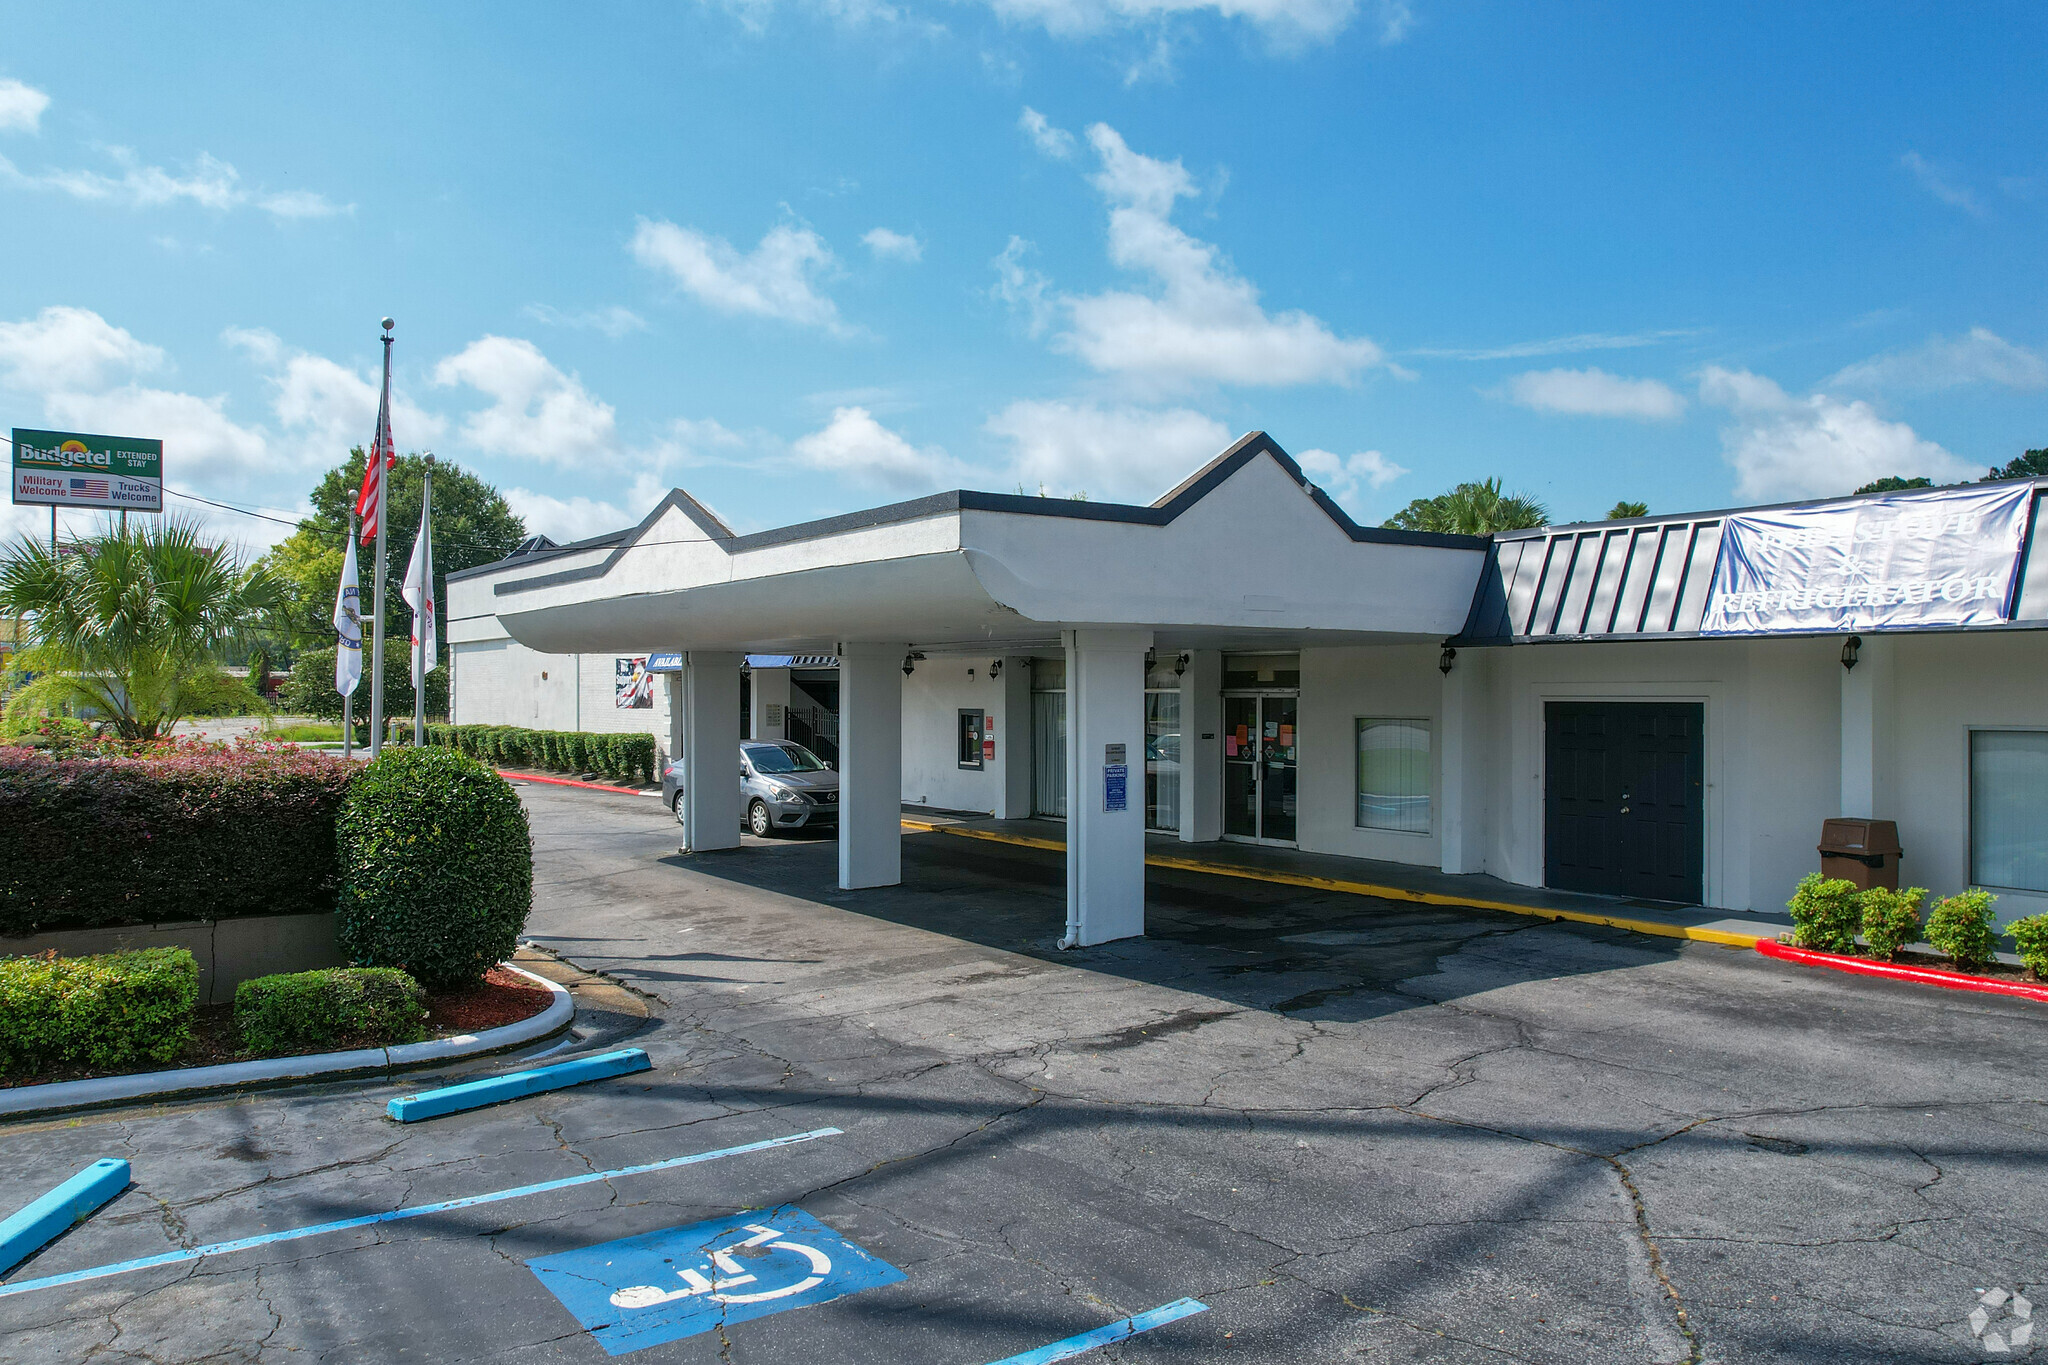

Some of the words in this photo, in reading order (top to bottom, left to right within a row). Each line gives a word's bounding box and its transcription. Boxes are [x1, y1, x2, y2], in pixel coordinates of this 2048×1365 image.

[20, 443, 111, 467] Budgetel
[117, 450, 157, 461] EXTENDED
[127, 459, 147, 468] STAY
[23, 475, 63, 488] Military
[118, 481, 150, 493] Trucks
[19, 485, 67, 497] Welcome
[111, 490, 157, 502] Welcome
[1854, 512, 1978, 544] STOVE
[1839, 554, 1866, 576] &
[1715, 576, 2002, 615] REFRIGERATOR
[652, 656, 682, 667] AVAILABL
